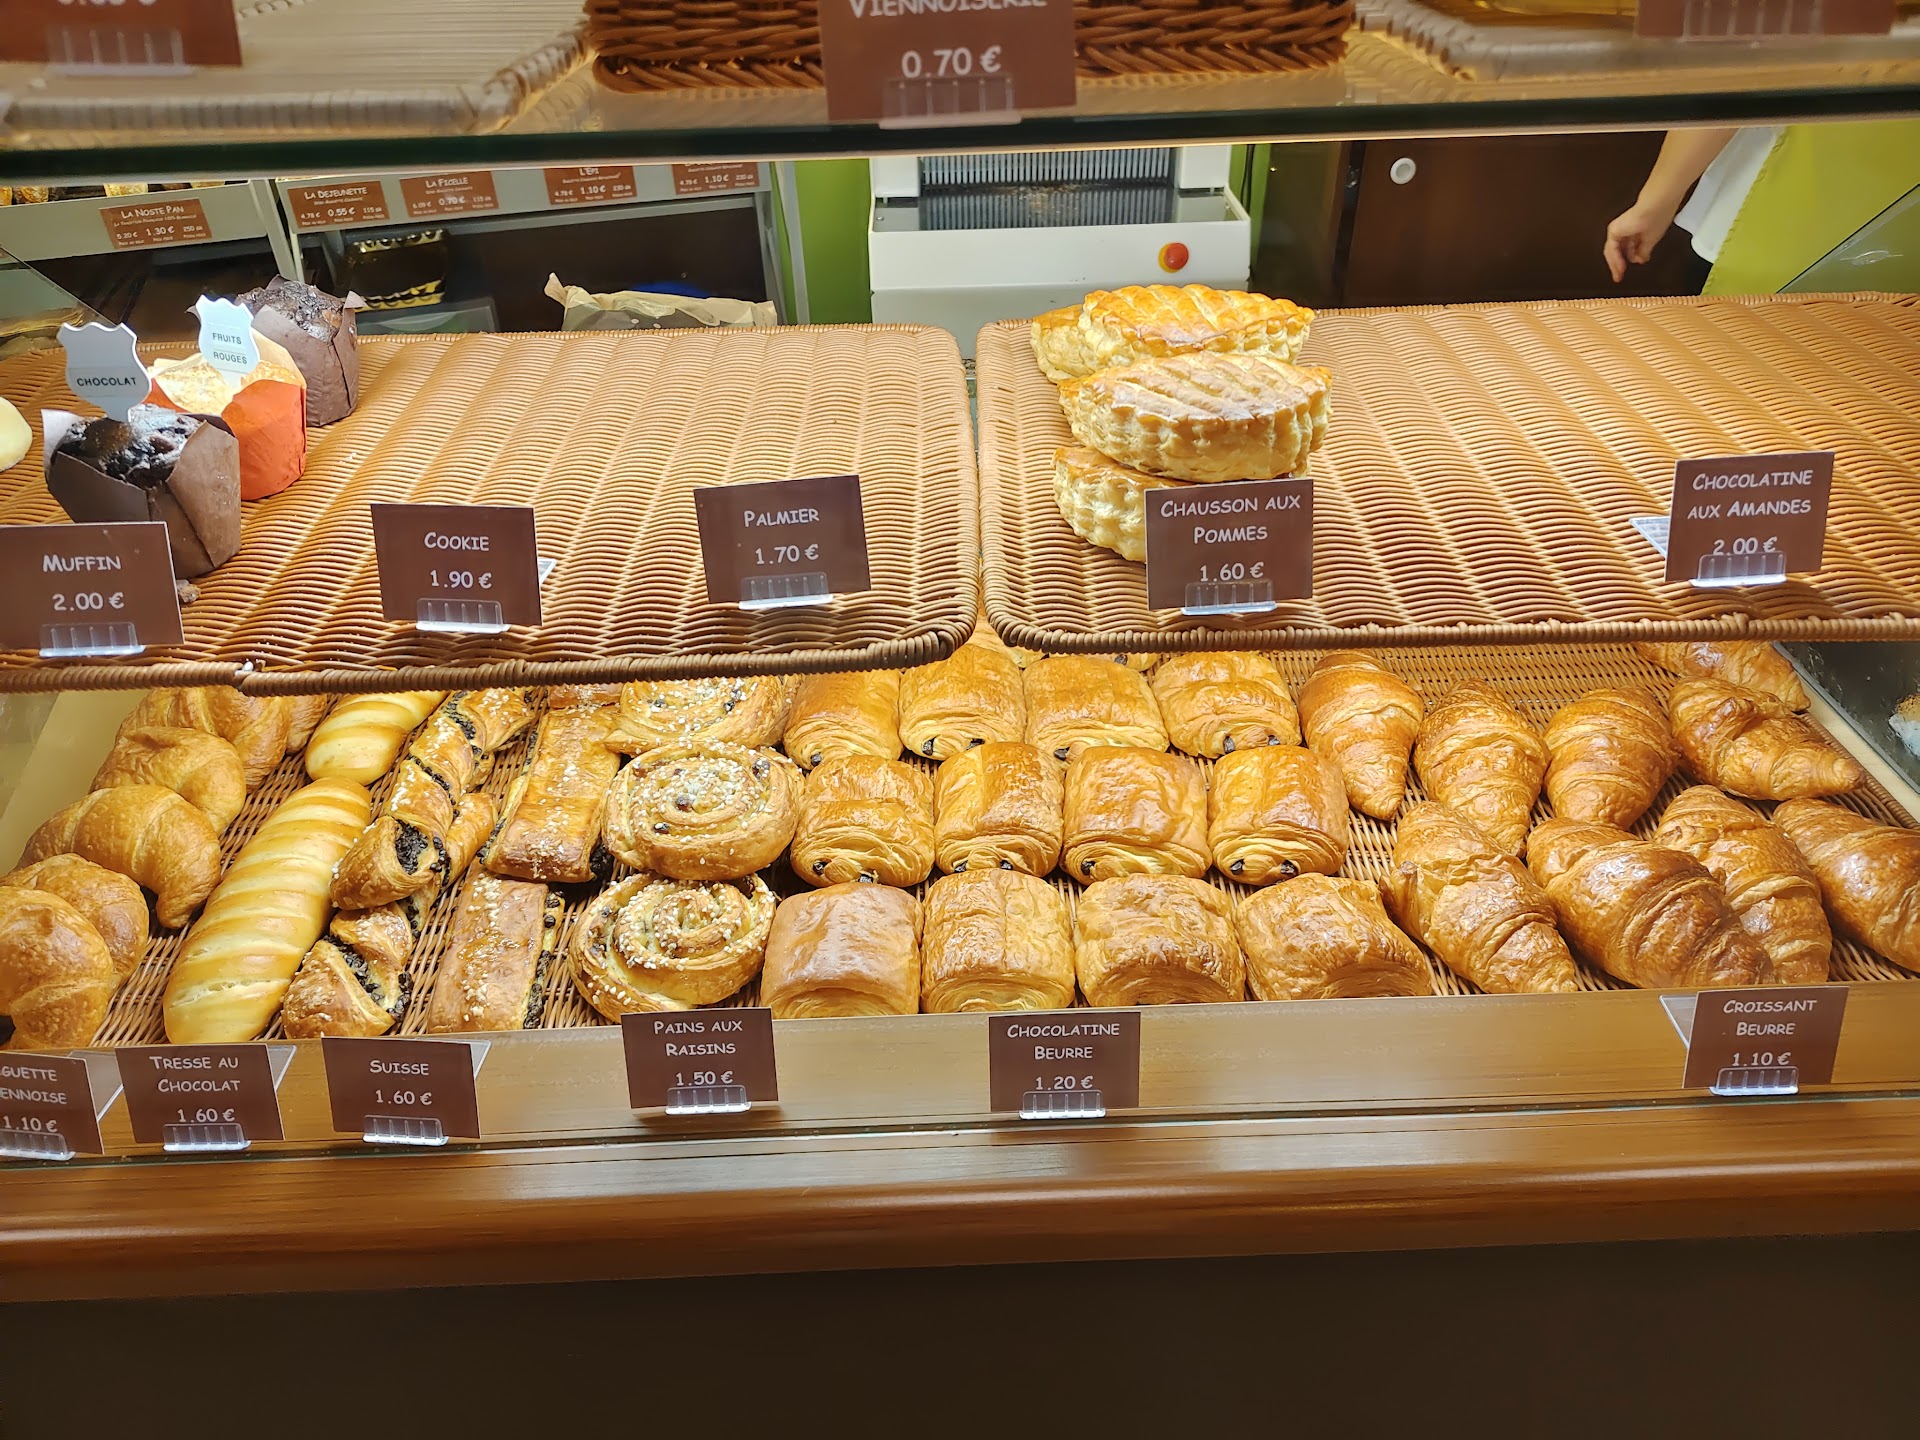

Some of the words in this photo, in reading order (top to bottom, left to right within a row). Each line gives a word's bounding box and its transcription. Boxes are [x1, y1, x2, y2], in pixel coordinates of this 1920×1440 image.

[902, 47, 972, 78] 0.70
[980, 45, 1002, 73] €
[304, 191, 316, 200] LA
[580, 186, 599, 195] 1.10
[438, 196, 458, 206] 0.70
[121, 210, 132, 219] LA
[135, 207, 165, 217] NOSTE
[166, 205, 184, 214] PAN
[327, 207, 347, 217] 0.55
[146, 226, 167, 236] 1.30
[167, 225, 175, 234] €
[212, 332, 242, 345] FRUITS
[213, 351, 247, 365] ROUGES
[76, 376, 137, 387] CHOCOLAT
[1692, 470, 1813, 491] CHOCOLATINE
[1160, 497, 1258, 517] CHAUSSON
[1265, 495, 1300, 511] AUX
[1687, 504, 1721, 520] AUX
[1726, 499, 1811, 517] AMANDES
[743, 508, 819, 527] PALMIER
[424, 531, 489, 551] COOKIE
[1193, 526, 1268, 544] POMMES
[755, 545, 800, 565] 1.70
[804, 543, 819, 561] €
[1713, 537, 1758, 556] 2.00
[1763, 536, 1777, 553] €
[42, 554, 121, 573] MUFFIN
[1200, 562, 1245, 582] 1.60
[1249, 561, 1264, 578] €
[430, 569, 473, 589] 1.90
[478, 572, 492, 589] €
[52, 592, 103, 611] 2.00
[109, 592, 124, 609] €
[1723, 999, 1817, 1014] CROISSANT
[653, 1020, 705, 1034] PAINS
[711, 1020, 743, 1033] AUX
[1006, 1023, 1120, 1038] CHOCOLATINE
[1736, 1021, 1796, 1036] BEURRE
[665, 1042, 736, 1057] RAISINS
[1034, 1045, 1093, 1060] BEURRE
[149, 1055, 212, 1070] TRESSE
[218, 1056, 239, 1069] AU
[1732, 1052, 1773, 1067] 1.10
[1777, 1051, 1791, 1066] €
[0, 1065, 58, 1081] GUETTE
[369, 1059, 430, 1076] SUISSE
[157, 1078, 241, 1093] CHOCOLAT
[675, 1071, 716, 1087] 1.50
[720, 1070, 734, 1084] €
[1035, 1076, 1076, 1091] 1.20
[1080, 1075, 1094, 1090] €
[0, 1086, 67, 1105] ENNOISE
[375, 1089, 415, 1105] 1.60
[419, 1091, 432, 1106] €
[177, 1108, 218, 1123] 1.60
[222, 1108, 235, 1122] €
[3, 1115, 41, 1131] 1.10
[45, 1119, 58, 1133] €
